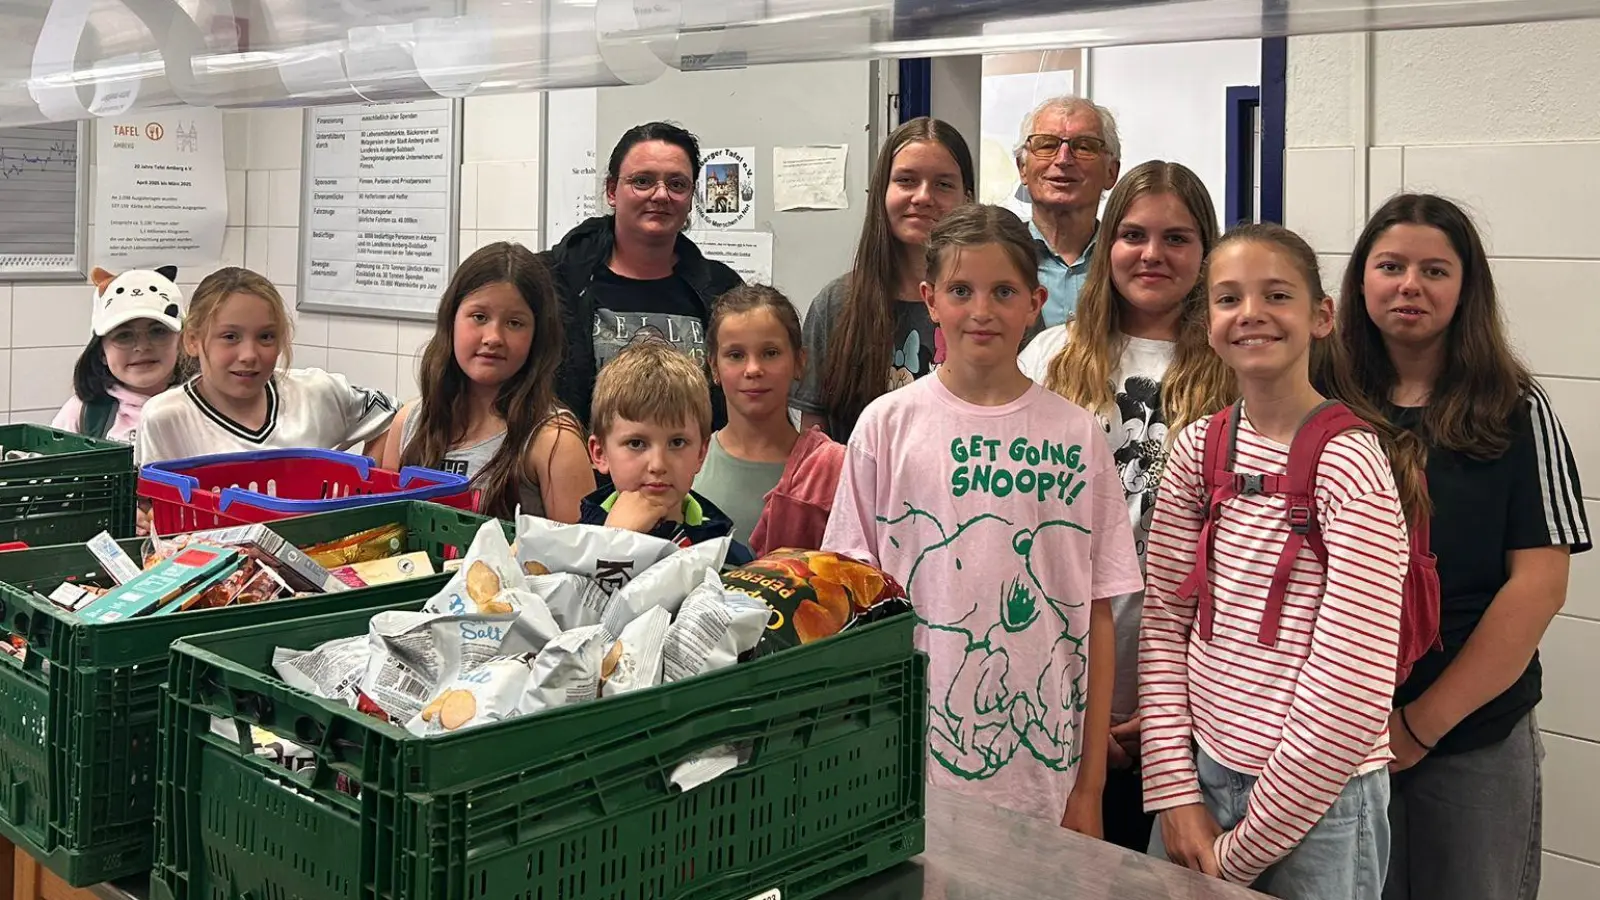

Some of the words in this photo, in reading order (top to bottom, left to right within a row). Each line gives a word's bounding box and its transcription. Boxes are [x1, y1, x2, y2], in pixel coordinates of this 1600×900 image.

[114, 125, 139, 136] TAFEL
[699, 150, 722, 167] berger
[725, 149, 743, 162] Tafel
[712, 218, 738, 228] Menschen
[742, 204, 750, 215] Not
[951, 435, 1001, 463] GET
[1009, 437, 1087, 473] GOING,
[951, 465, 1086, 506] SNOOPY!
[460, 620, 502, 642] Salt
